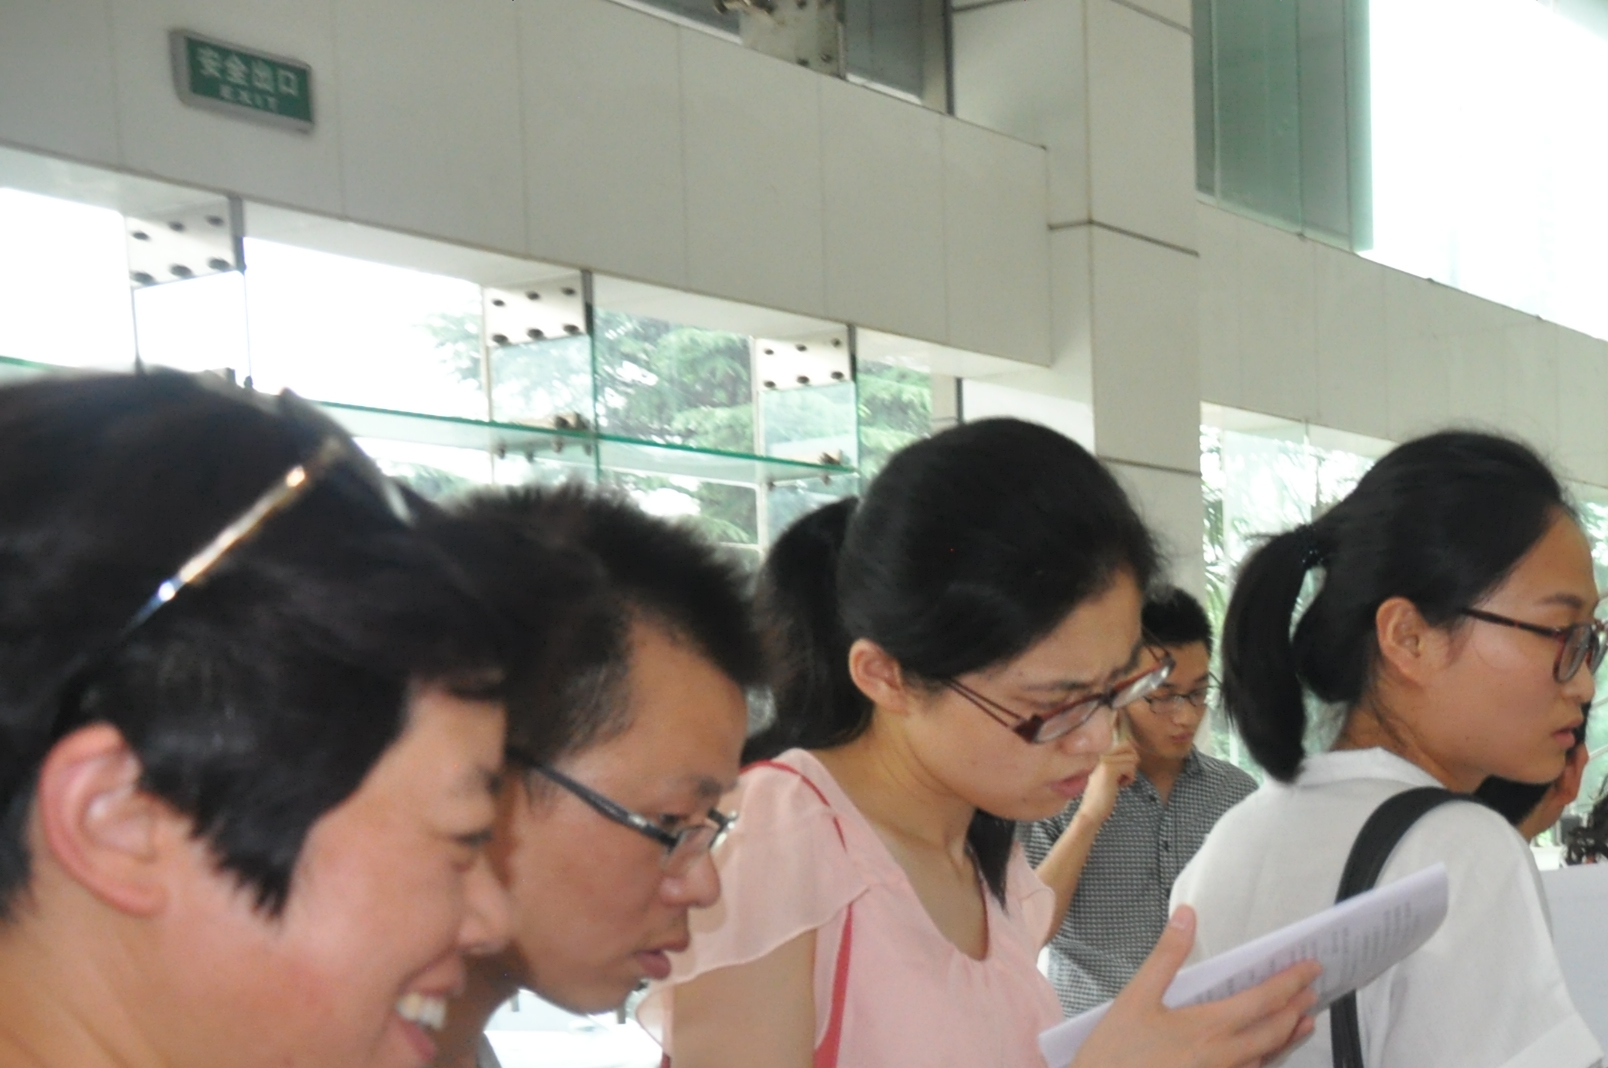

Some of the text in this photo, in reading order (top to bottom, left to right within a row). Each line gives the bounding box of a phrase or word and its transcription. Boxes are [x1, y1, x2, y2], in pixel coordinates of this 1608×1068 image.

[196, 45, 299, 97] 安全出口
[219, 84, 279, 113] EXIT
